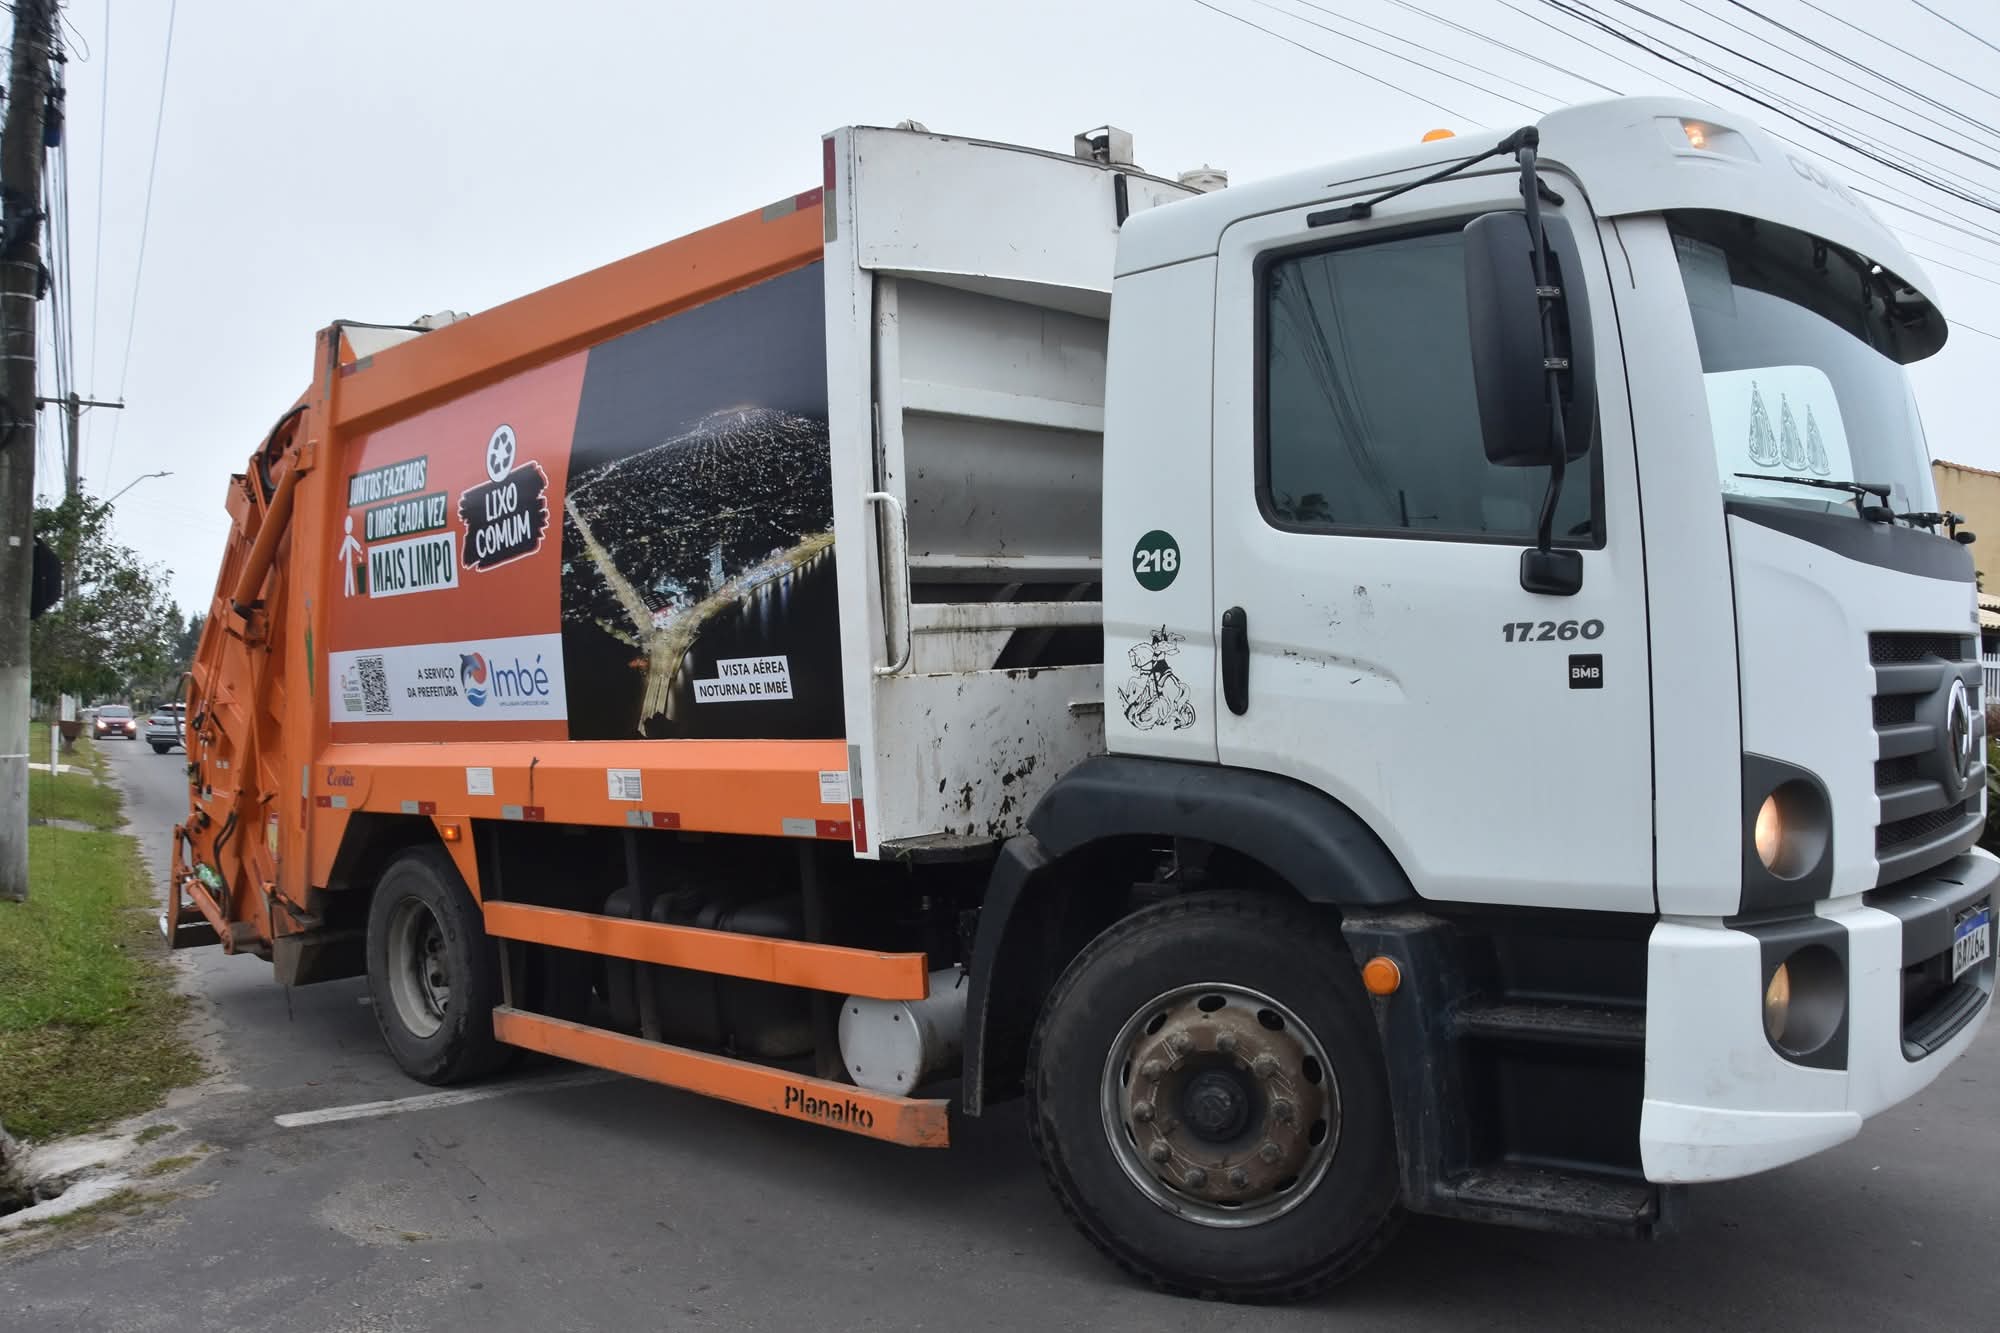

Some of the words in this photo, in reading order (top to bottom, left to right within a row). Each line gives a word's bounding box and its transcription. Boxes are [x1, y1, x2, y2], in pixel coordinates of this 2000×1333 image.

[383, 460, 427, 497] FAZEMOS
[367, 511, 373, 540] O
[375, 500, 398, 537] IMBÉ
[399, 499, 424, 532] CADA
[427, 494, 446, 527] VEZ
[485, 482, 518, 522] LIXO
[475, 510, 531, 558] COMUM
[372, 547, 405, 593] MAIS
[410, 540, 452, 588] LIMPO
[1136, 548, 1177, 573] 218
[1502, 619, 1604, 642] 17.260
[417, 669, 422, 680] A
[424, 667, 455, 682] SERVIÇO
[489, 654, 550, 698] Imbé
[722, 663, 750, 677] VISTA
[753, 659, 785, 675] AÉREA
[1571, 667, 1600, 679] BMB
[407, 687, 417, 698] DA
[418, 685, 459, 698] PREFEITURA
[699, 682, 747, 697] NOTURNA
[750, 682, 761, 695] DE
[764, 678, 788, 694] IMBÉ
[785, 1085, 874, 1129] Planalto
